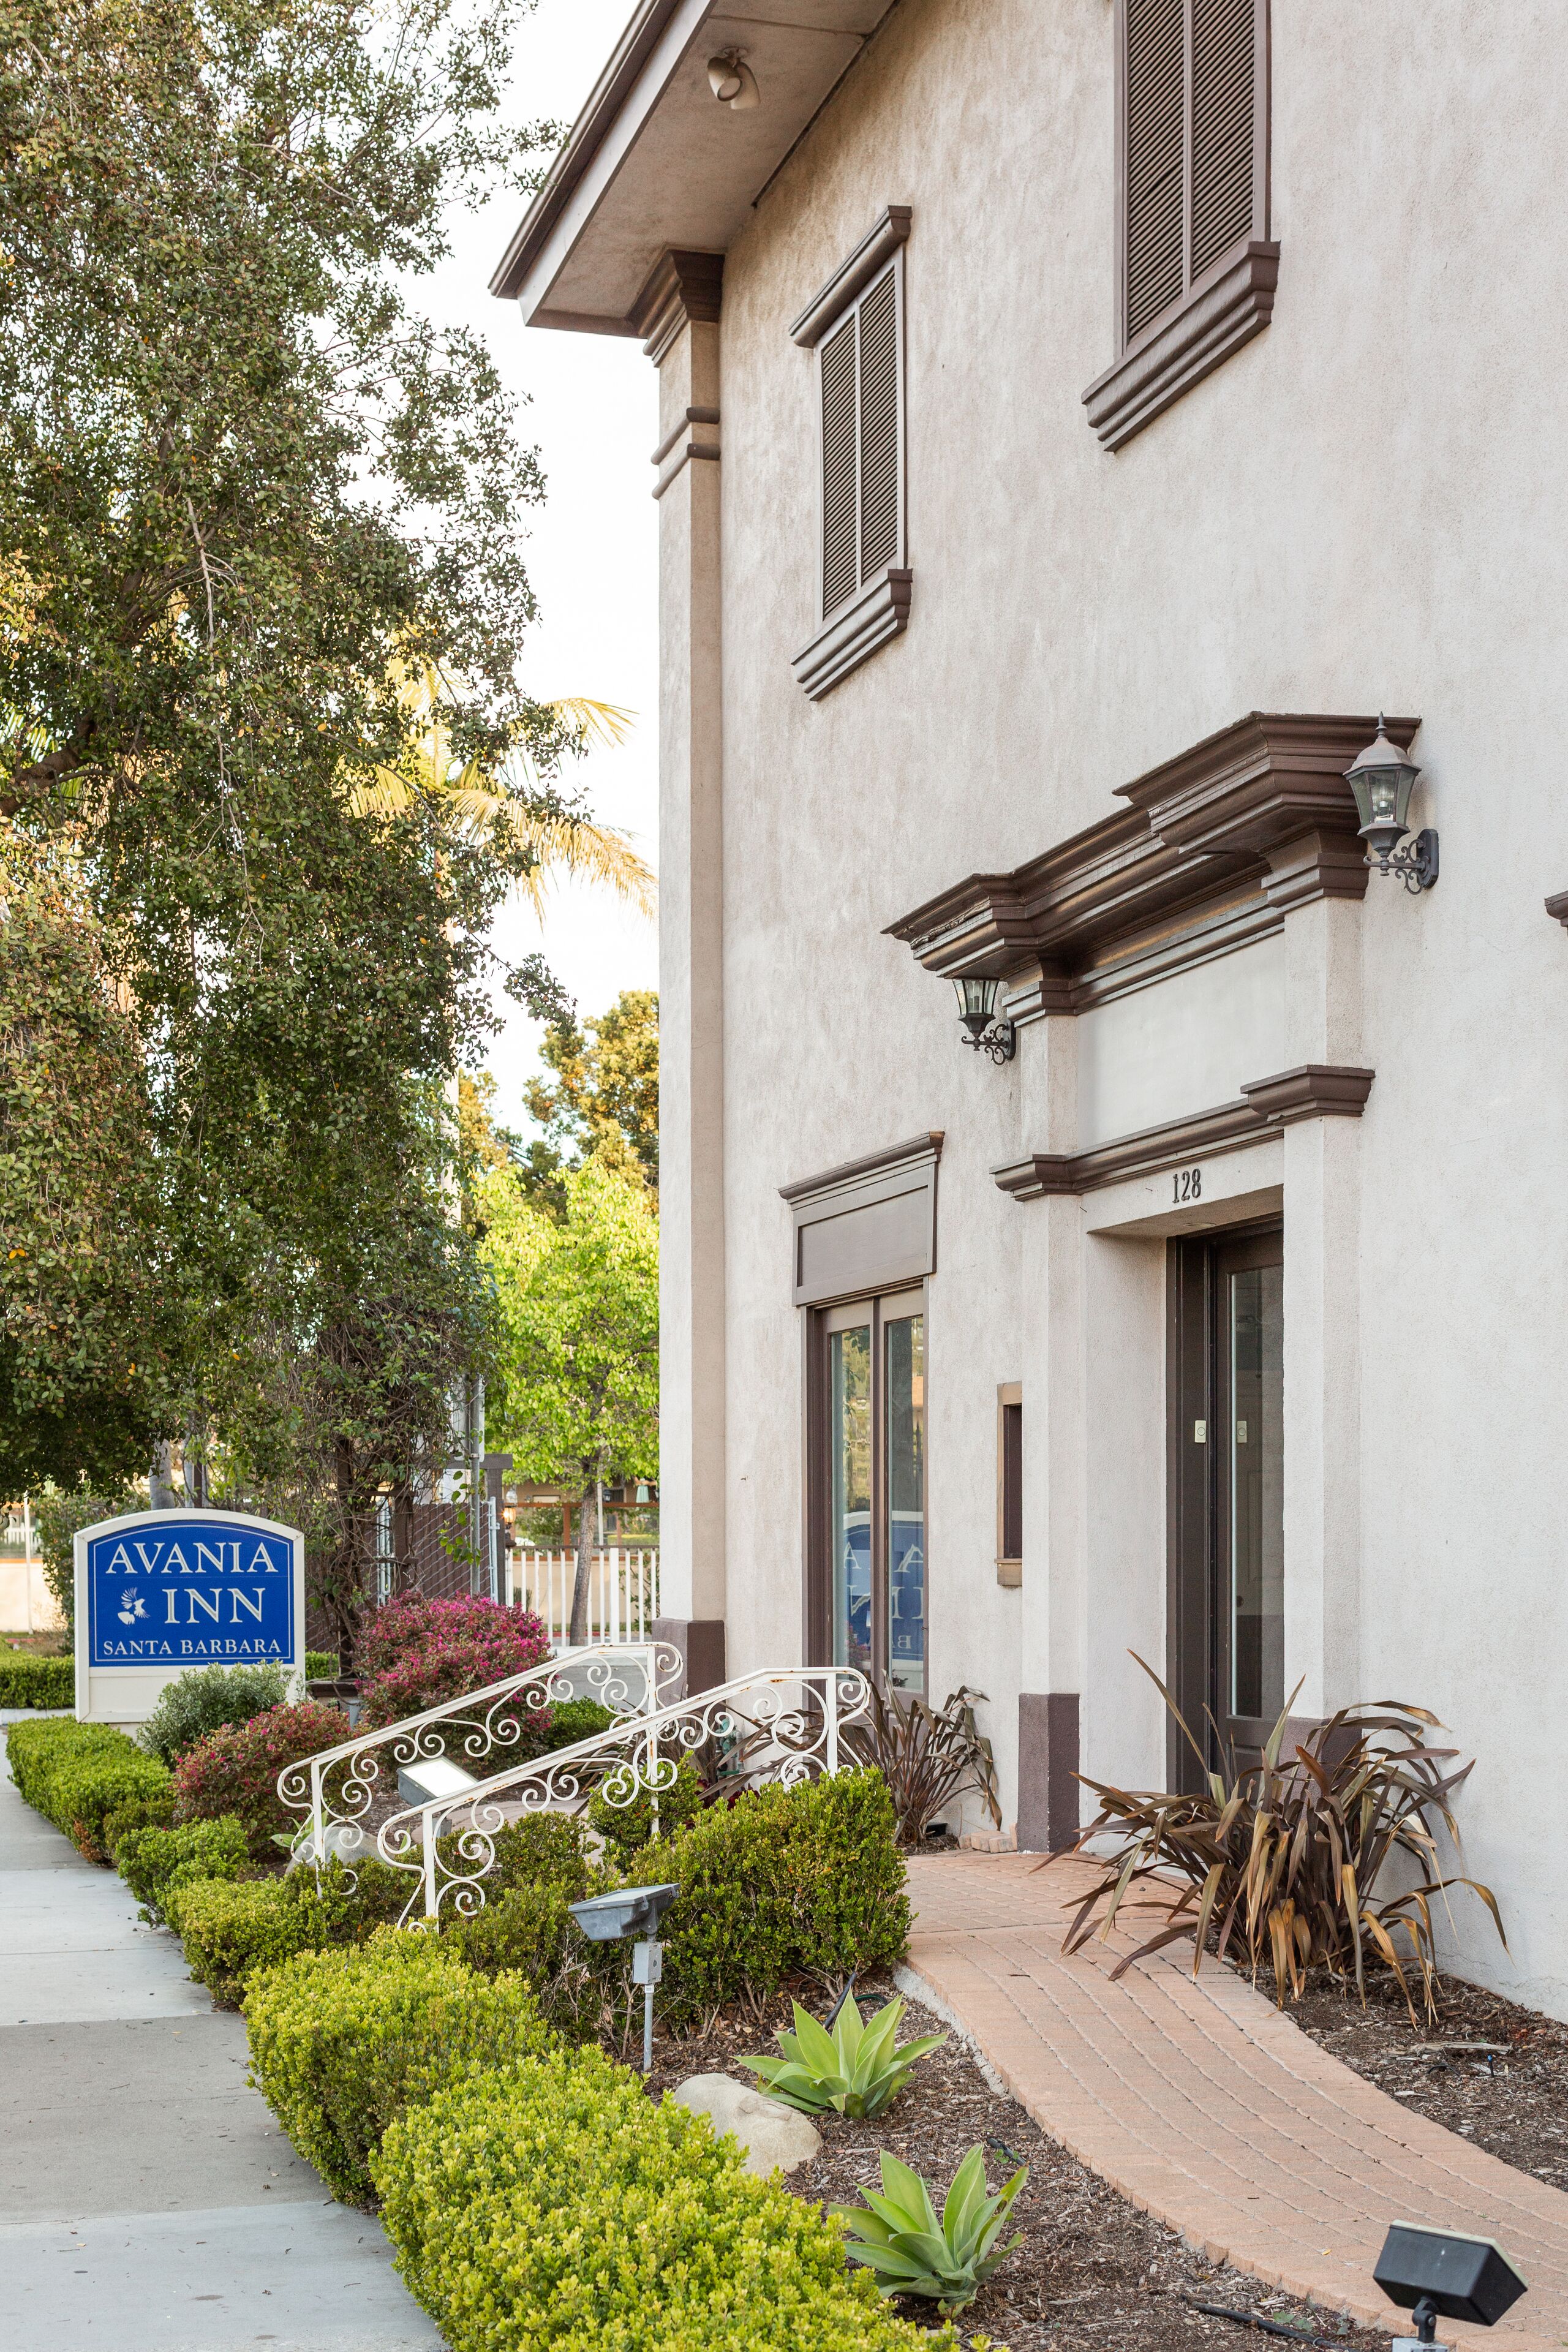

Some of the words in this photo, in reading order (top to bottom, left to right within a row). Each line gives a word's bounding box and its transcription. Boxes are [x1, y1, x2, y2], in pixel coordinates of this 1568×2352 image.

[1172, 1169, 1201, 1204] 128
[105, 1542, 279, 1574] AVANIA
[162, 1588, 266, 1624] INN
[104, 1640, 173, 1655] SANTA
[180, 1638, 282, 1654] BARBARA
